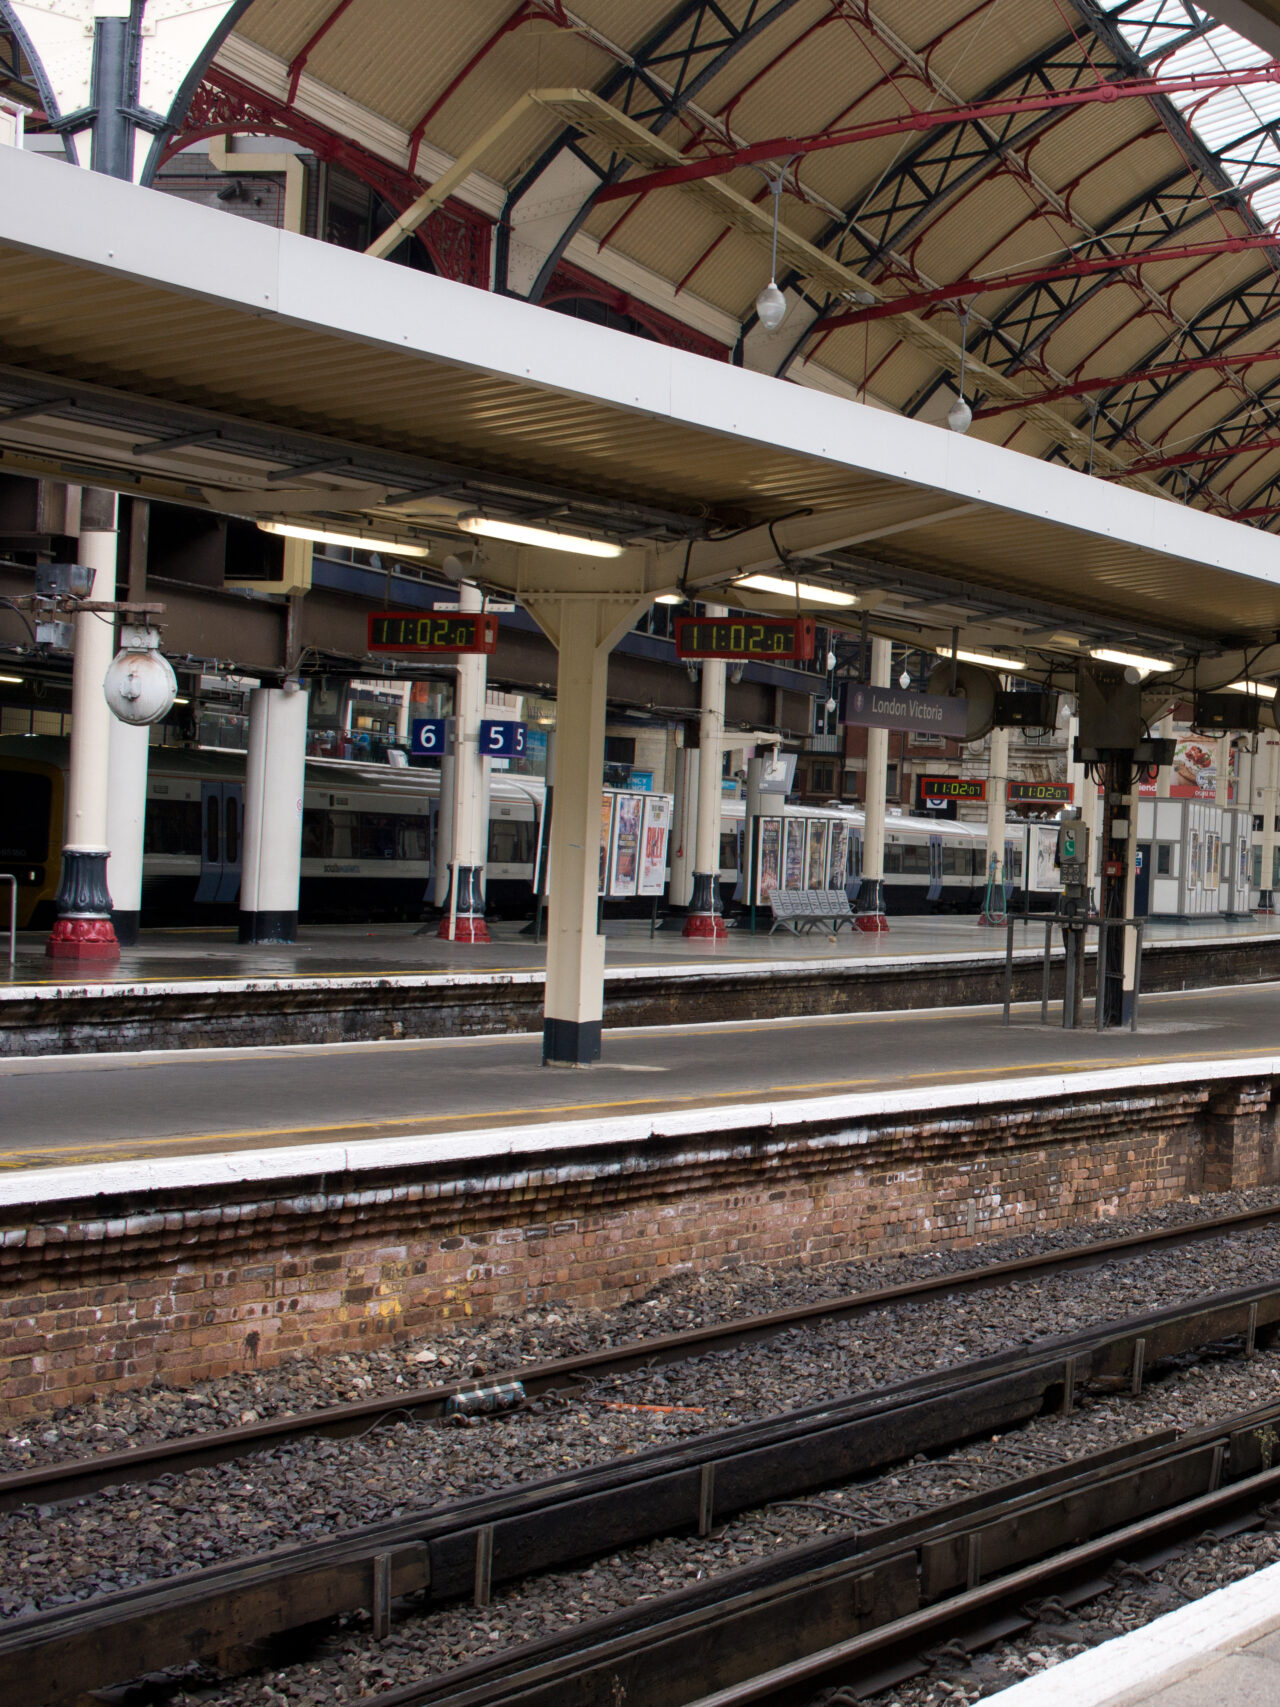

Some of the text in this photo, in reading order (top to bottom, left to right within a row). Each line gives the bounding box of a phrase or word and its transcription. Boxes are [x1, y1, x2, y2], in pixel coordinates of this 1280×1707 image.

[872, 695, 943, 721] London Victoria
[420, 724, 436, 748] 6
[488, 726, 504, 749] 5
[516, 728, 524, 751] 5
[1139, 783, 1157, 792] iend
